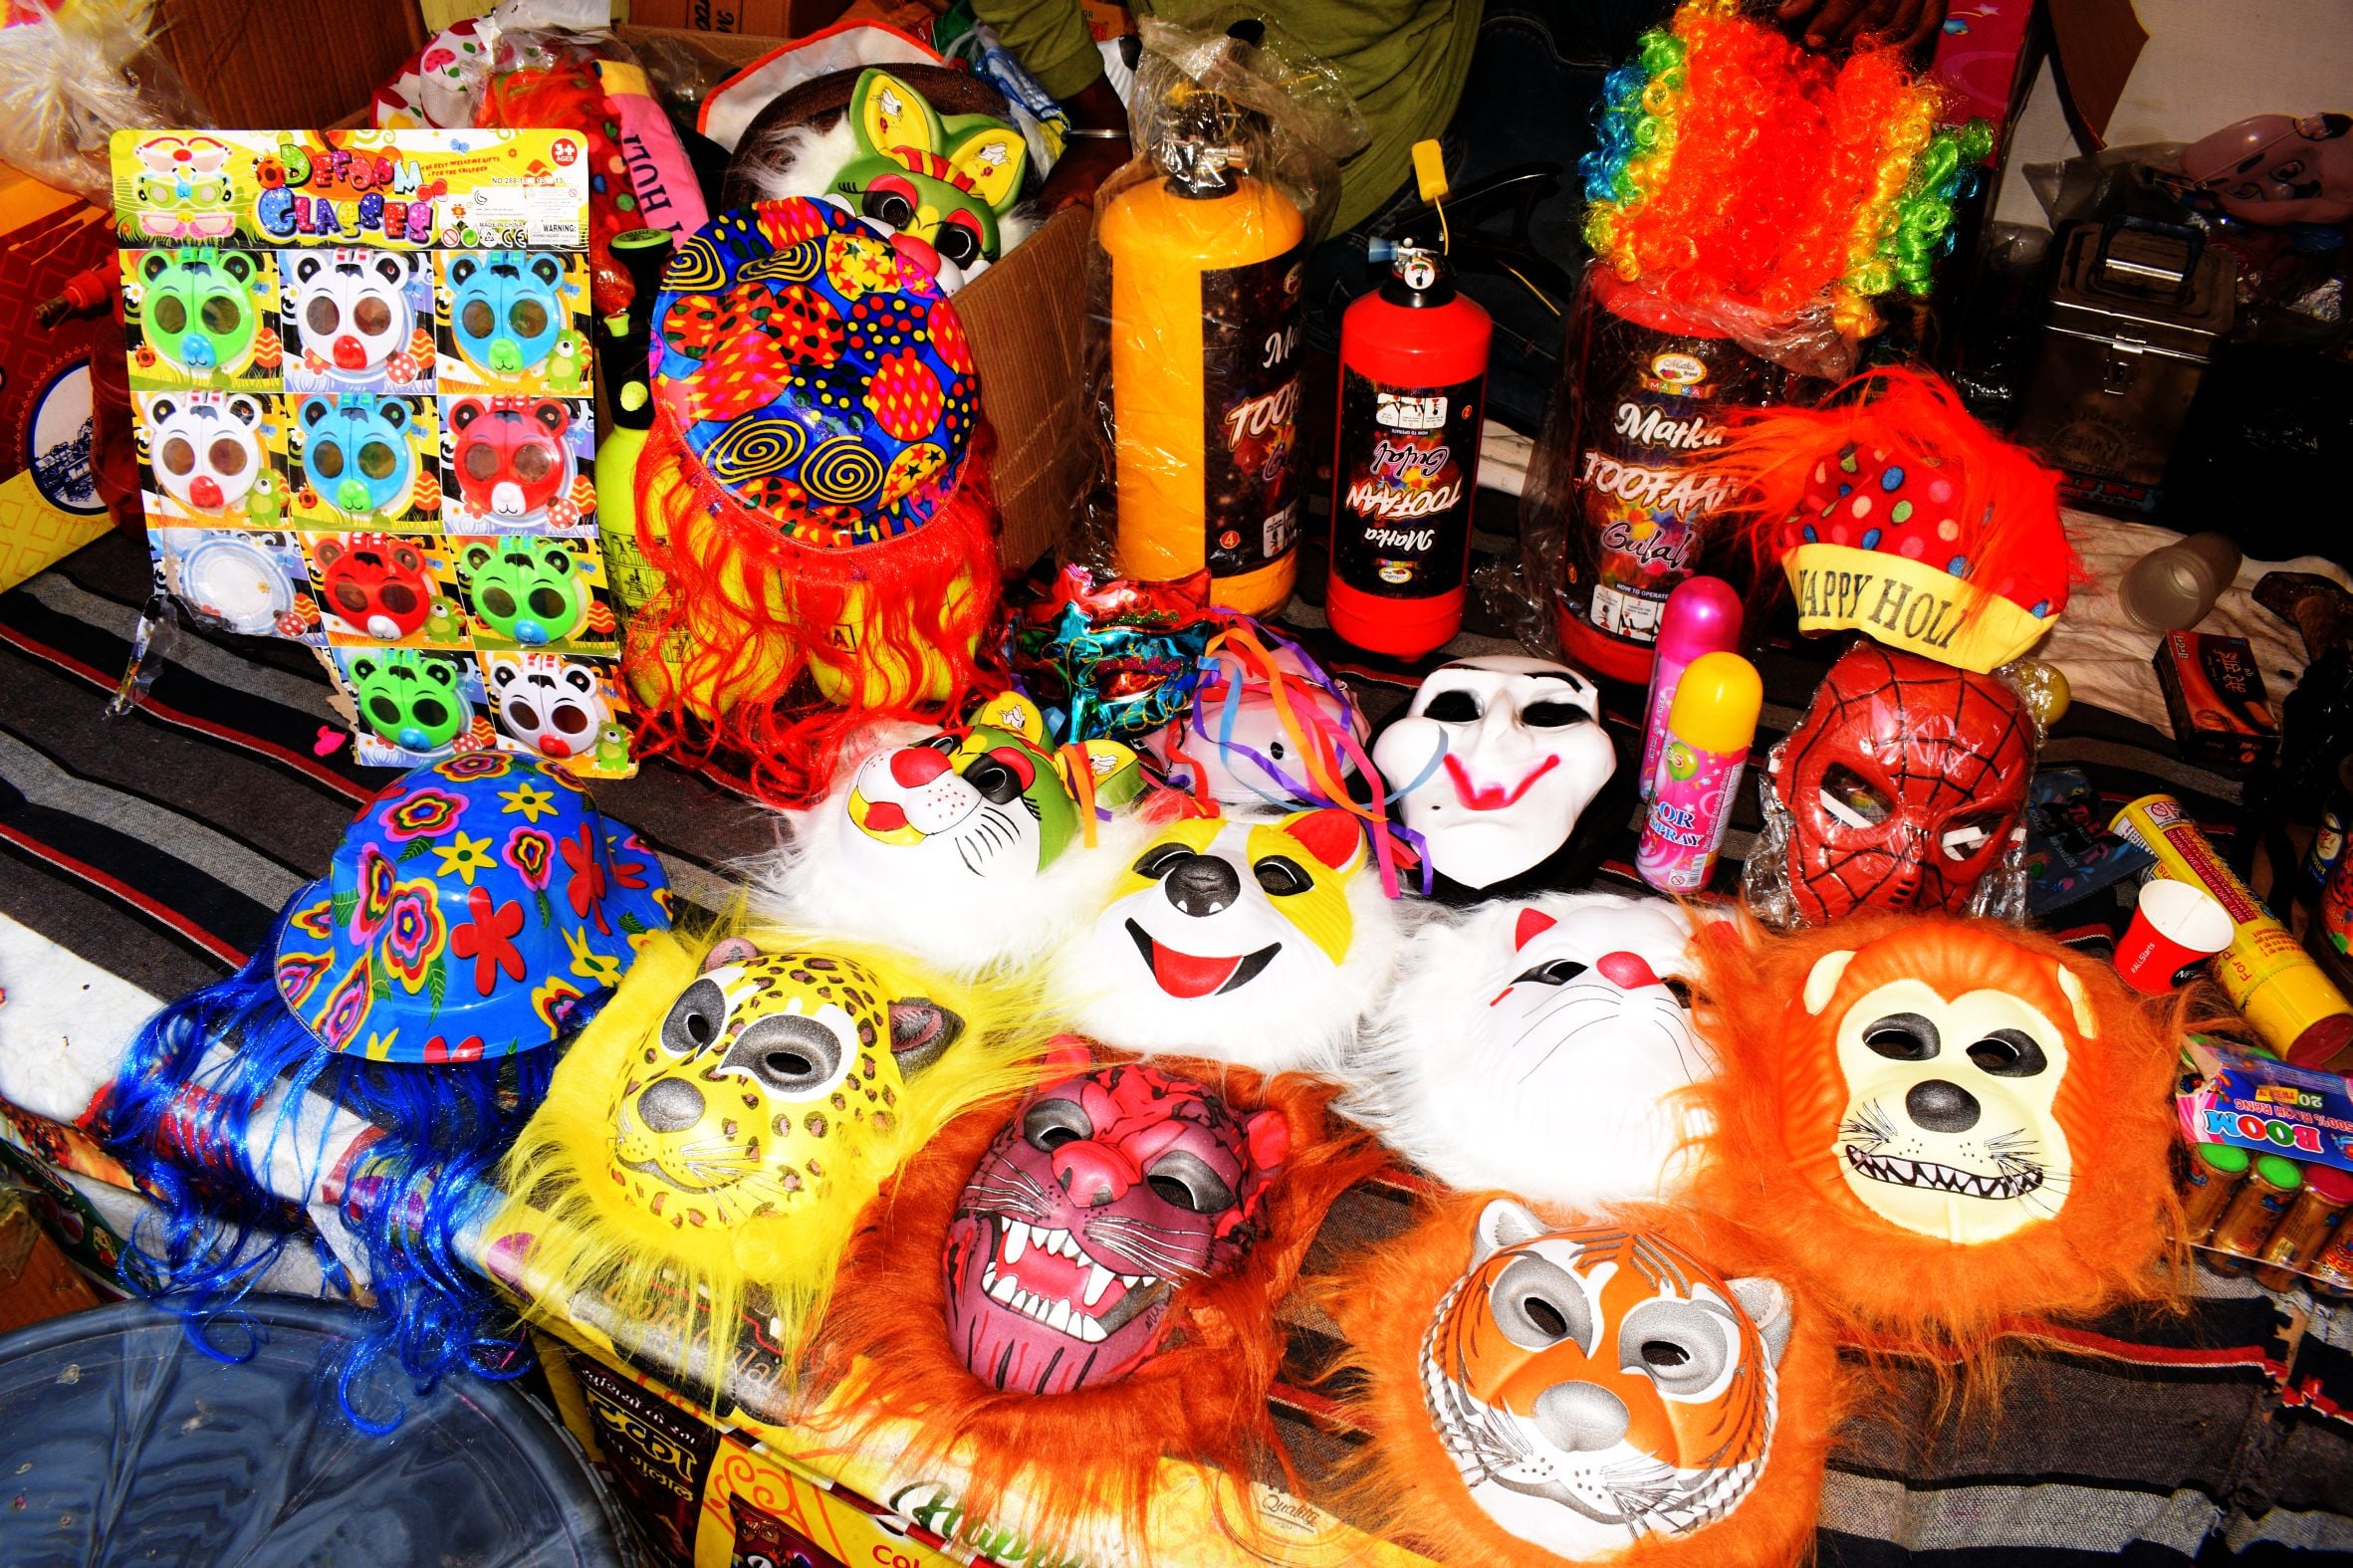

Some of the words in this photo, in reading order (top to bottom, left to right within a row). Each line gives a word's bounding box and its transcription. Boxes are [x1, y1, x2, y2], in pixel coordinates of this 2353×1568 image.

[554, 142, 575, 155] 3+
[279, 143, 423, 194] DEFORM
[258, 186, 434, 244] GLASSES
[1649, 381, 1702, 397] MATKA
[1614, 402, 1728, 449] Matka
[1370, 440, 1450, 478] Gulal
[1345, 476, 1464, 519] TOOFAAN
[1363, 527, 1436, 552] Matka
[1601, 520, 1696, 570] Gulal
[1616, 583, 1631, 592] HOW
[1867, 577, 1968, 650] HOLI
[1648, 815, 1706, 848] SPRAY
[2166, 830, 2188, 857] SHAKE
[2187, 854, 2205, 877] WELL
[2204, 874, 2233, 904] BEFORE
[2231, 903, 2245, 923] USE
[2130, 942, 2156, 974] #ALLStarts
[2233, 961, 2252, 982] For
[2234, 1098, 2273, 1115] RANG
[2298, 1093, 2323, 1108] 20
[2202, 1109, 2325, 1154] BOOM
[1262, 1493, 1320, 1527] Quality
